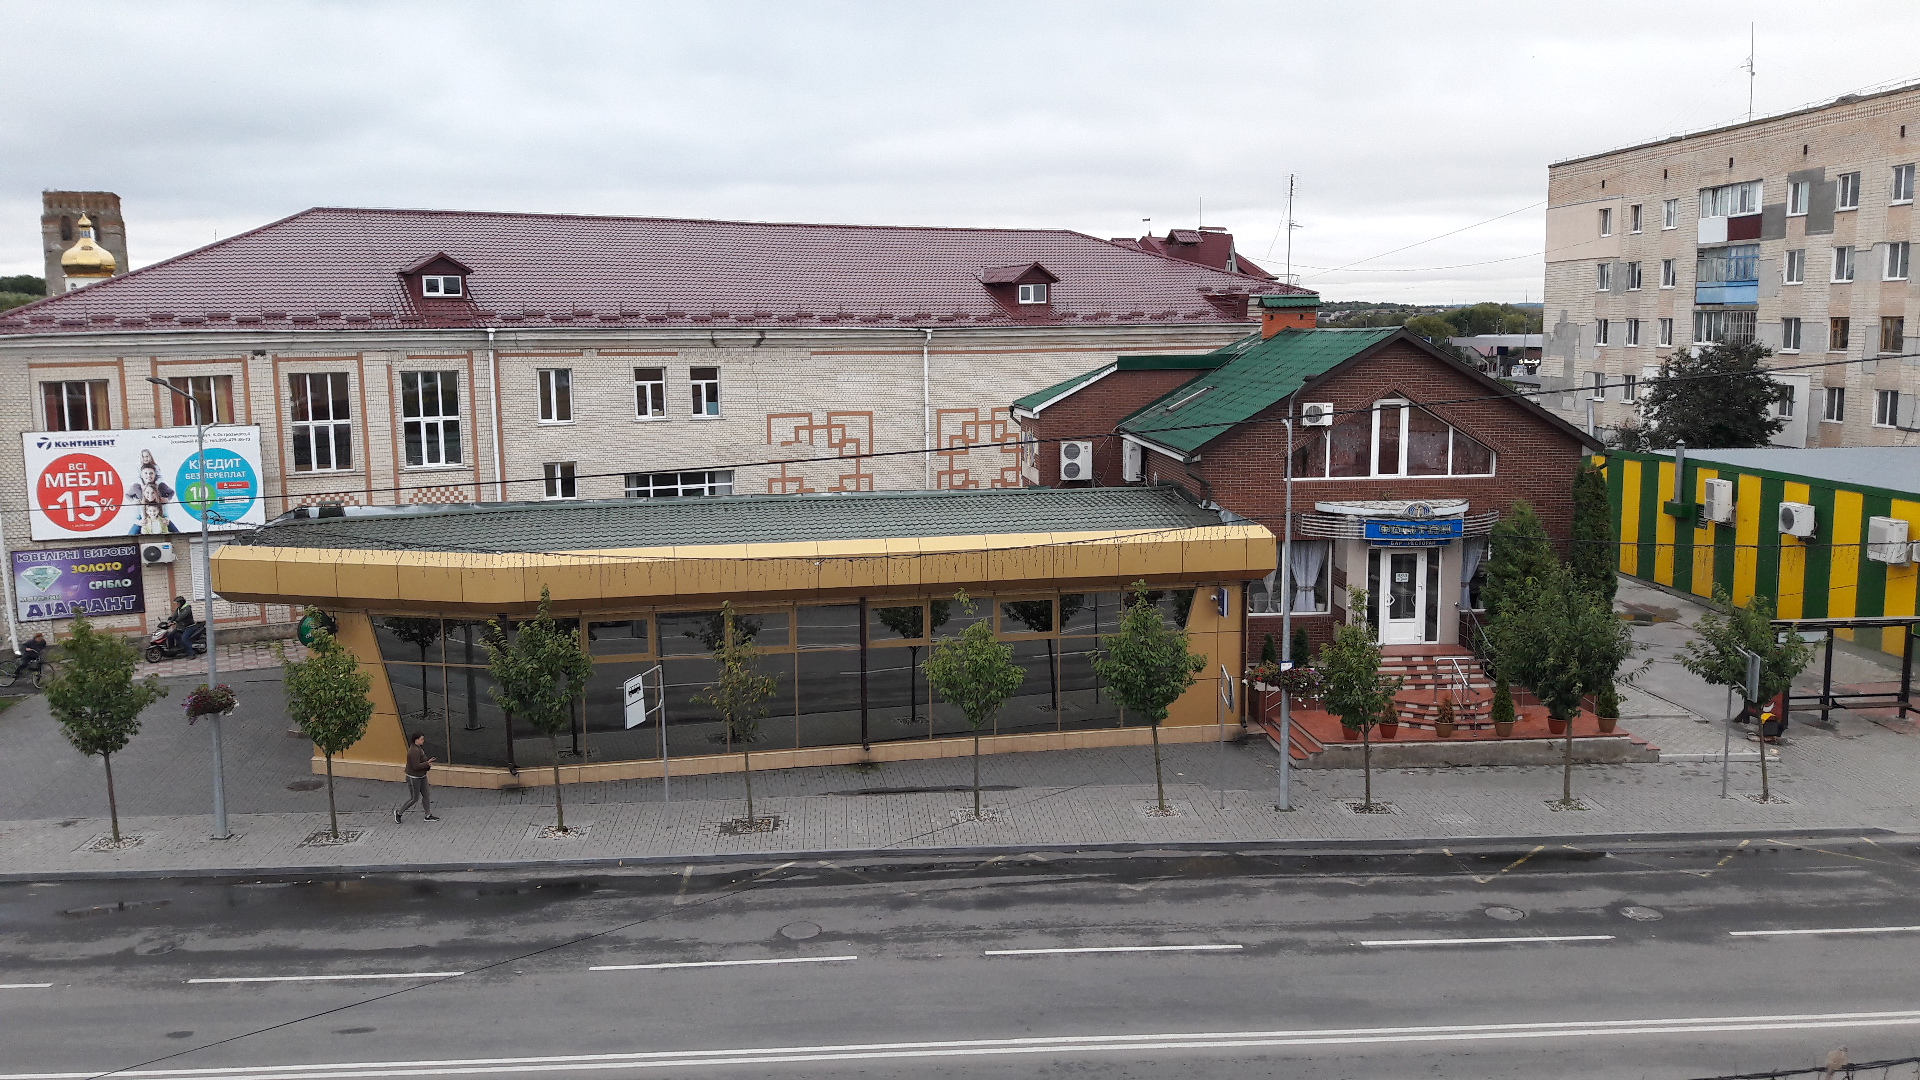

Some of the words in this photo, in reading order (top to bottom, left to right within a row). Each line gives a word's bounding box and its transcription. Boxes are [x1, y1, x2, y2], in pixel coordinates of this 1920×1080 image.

[54, 439, 115, 448] КОНТИНЕНТ
[68, 462, 87, 471] ВСІ
[44, 470, 113, 488] МЕБЛІ
[203, 471, 247, 479] ПЕРЕПЛАТ
[16, 550, 80, 563] ЮВЕЛІРНІ
[84, 545, 136, 559] ВИРОБИ
[71, 561, 123, 574] ЗОЛОТО
[88, 578, 132, 590] СРІБЛО
[26, 595, 137, 618] ДІАМАНТ
